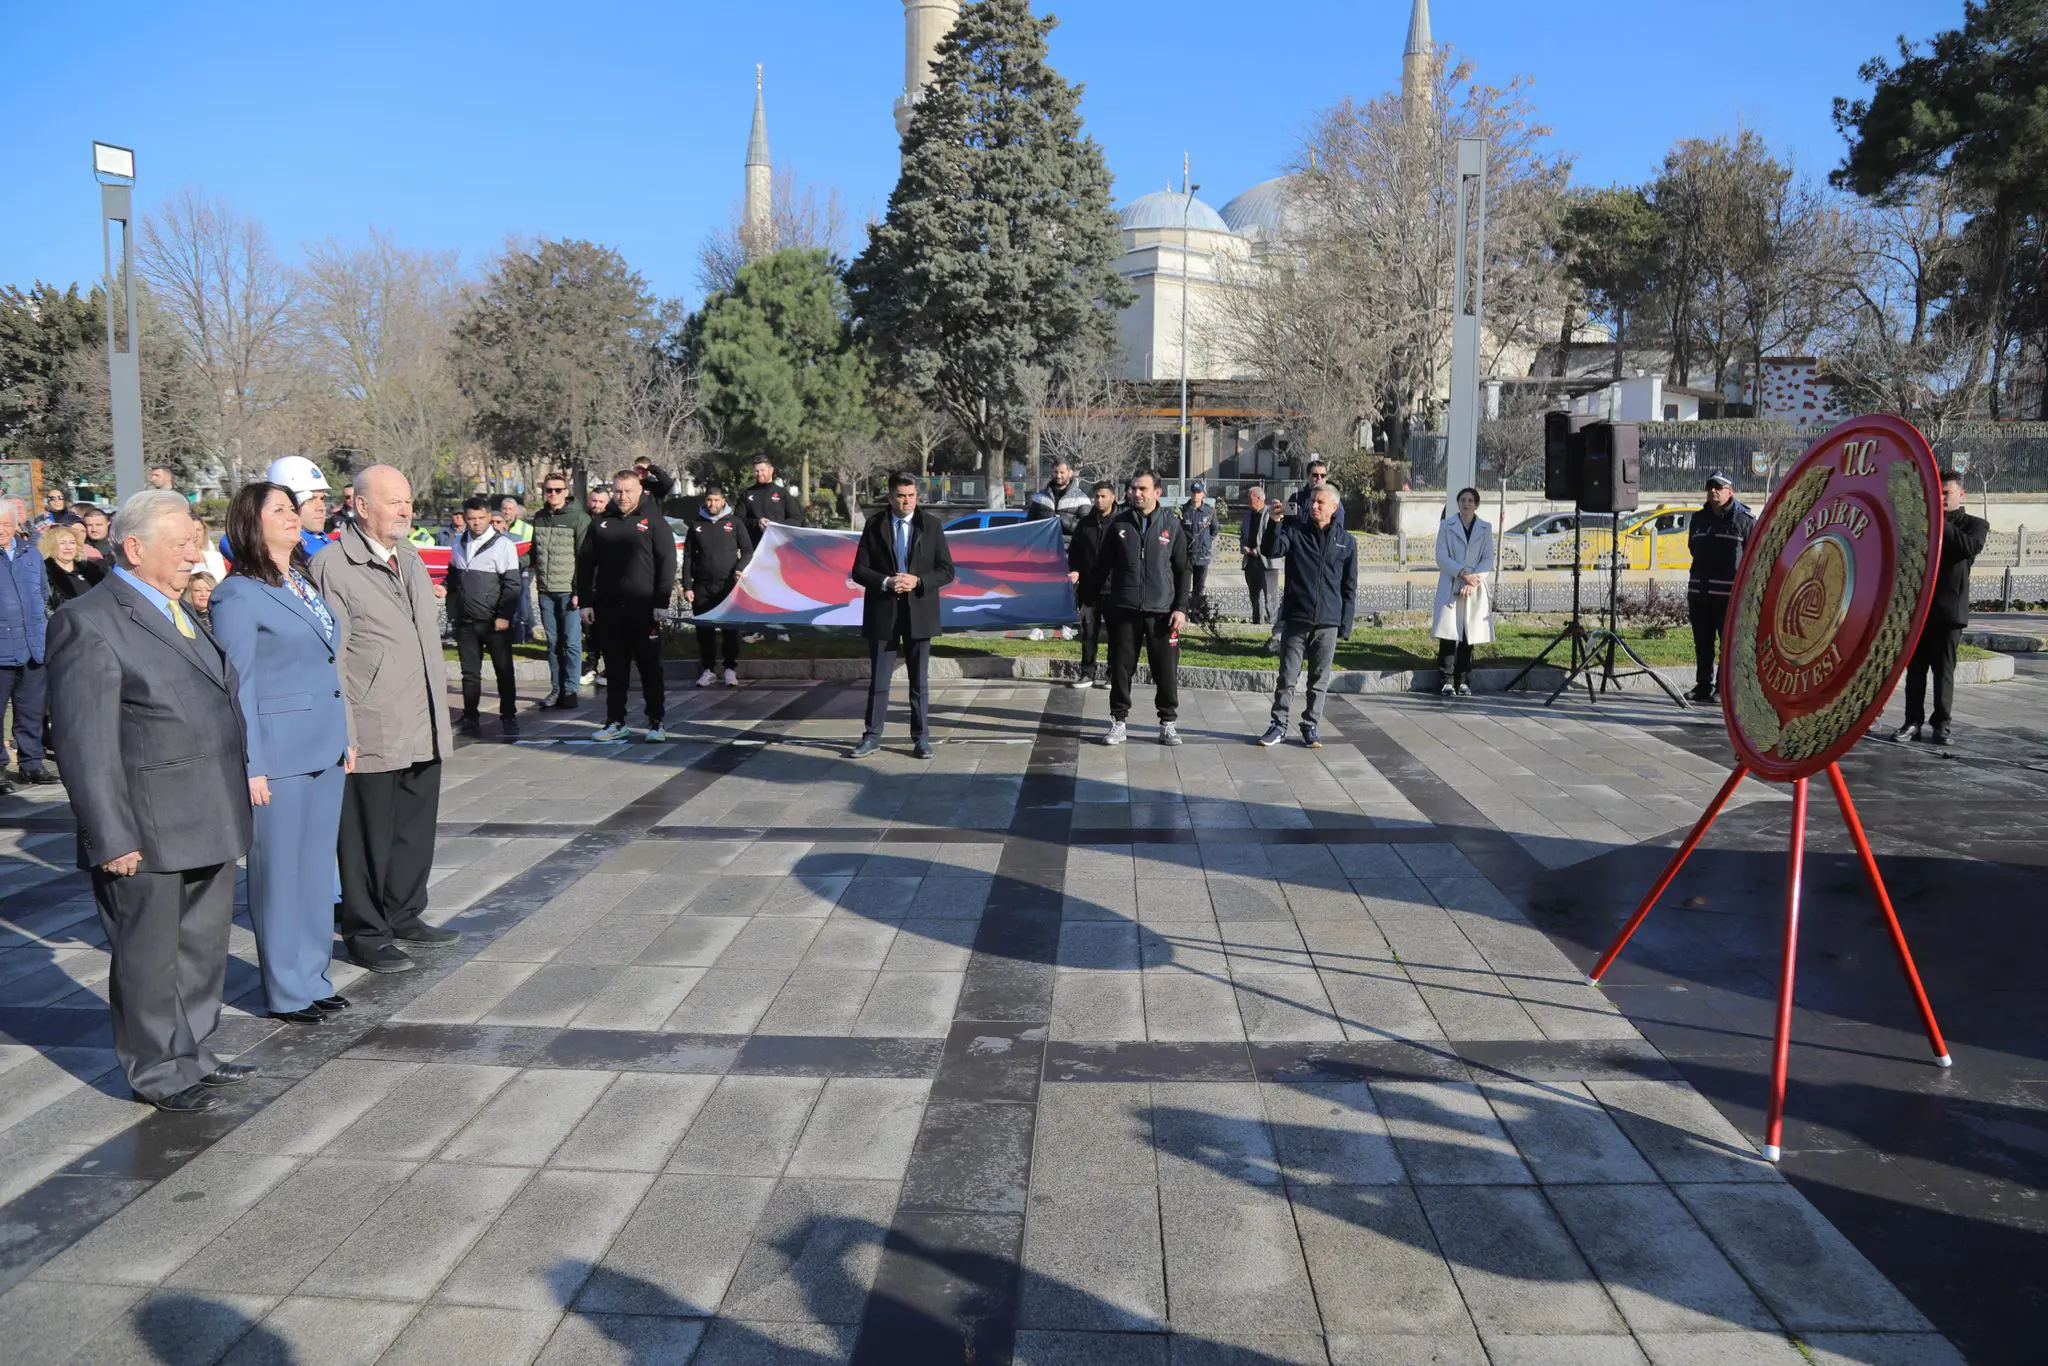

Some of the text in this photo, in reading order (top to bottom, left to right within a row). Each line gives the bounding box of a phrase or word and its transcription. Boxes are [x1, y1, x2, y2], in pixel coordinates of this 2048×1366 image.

[1843, 440, 1877, 477] T.C.
[1804, 499, 1869, 539] EDİRNE
[1760, 633, 1841, 695] BELEDİYESİ
